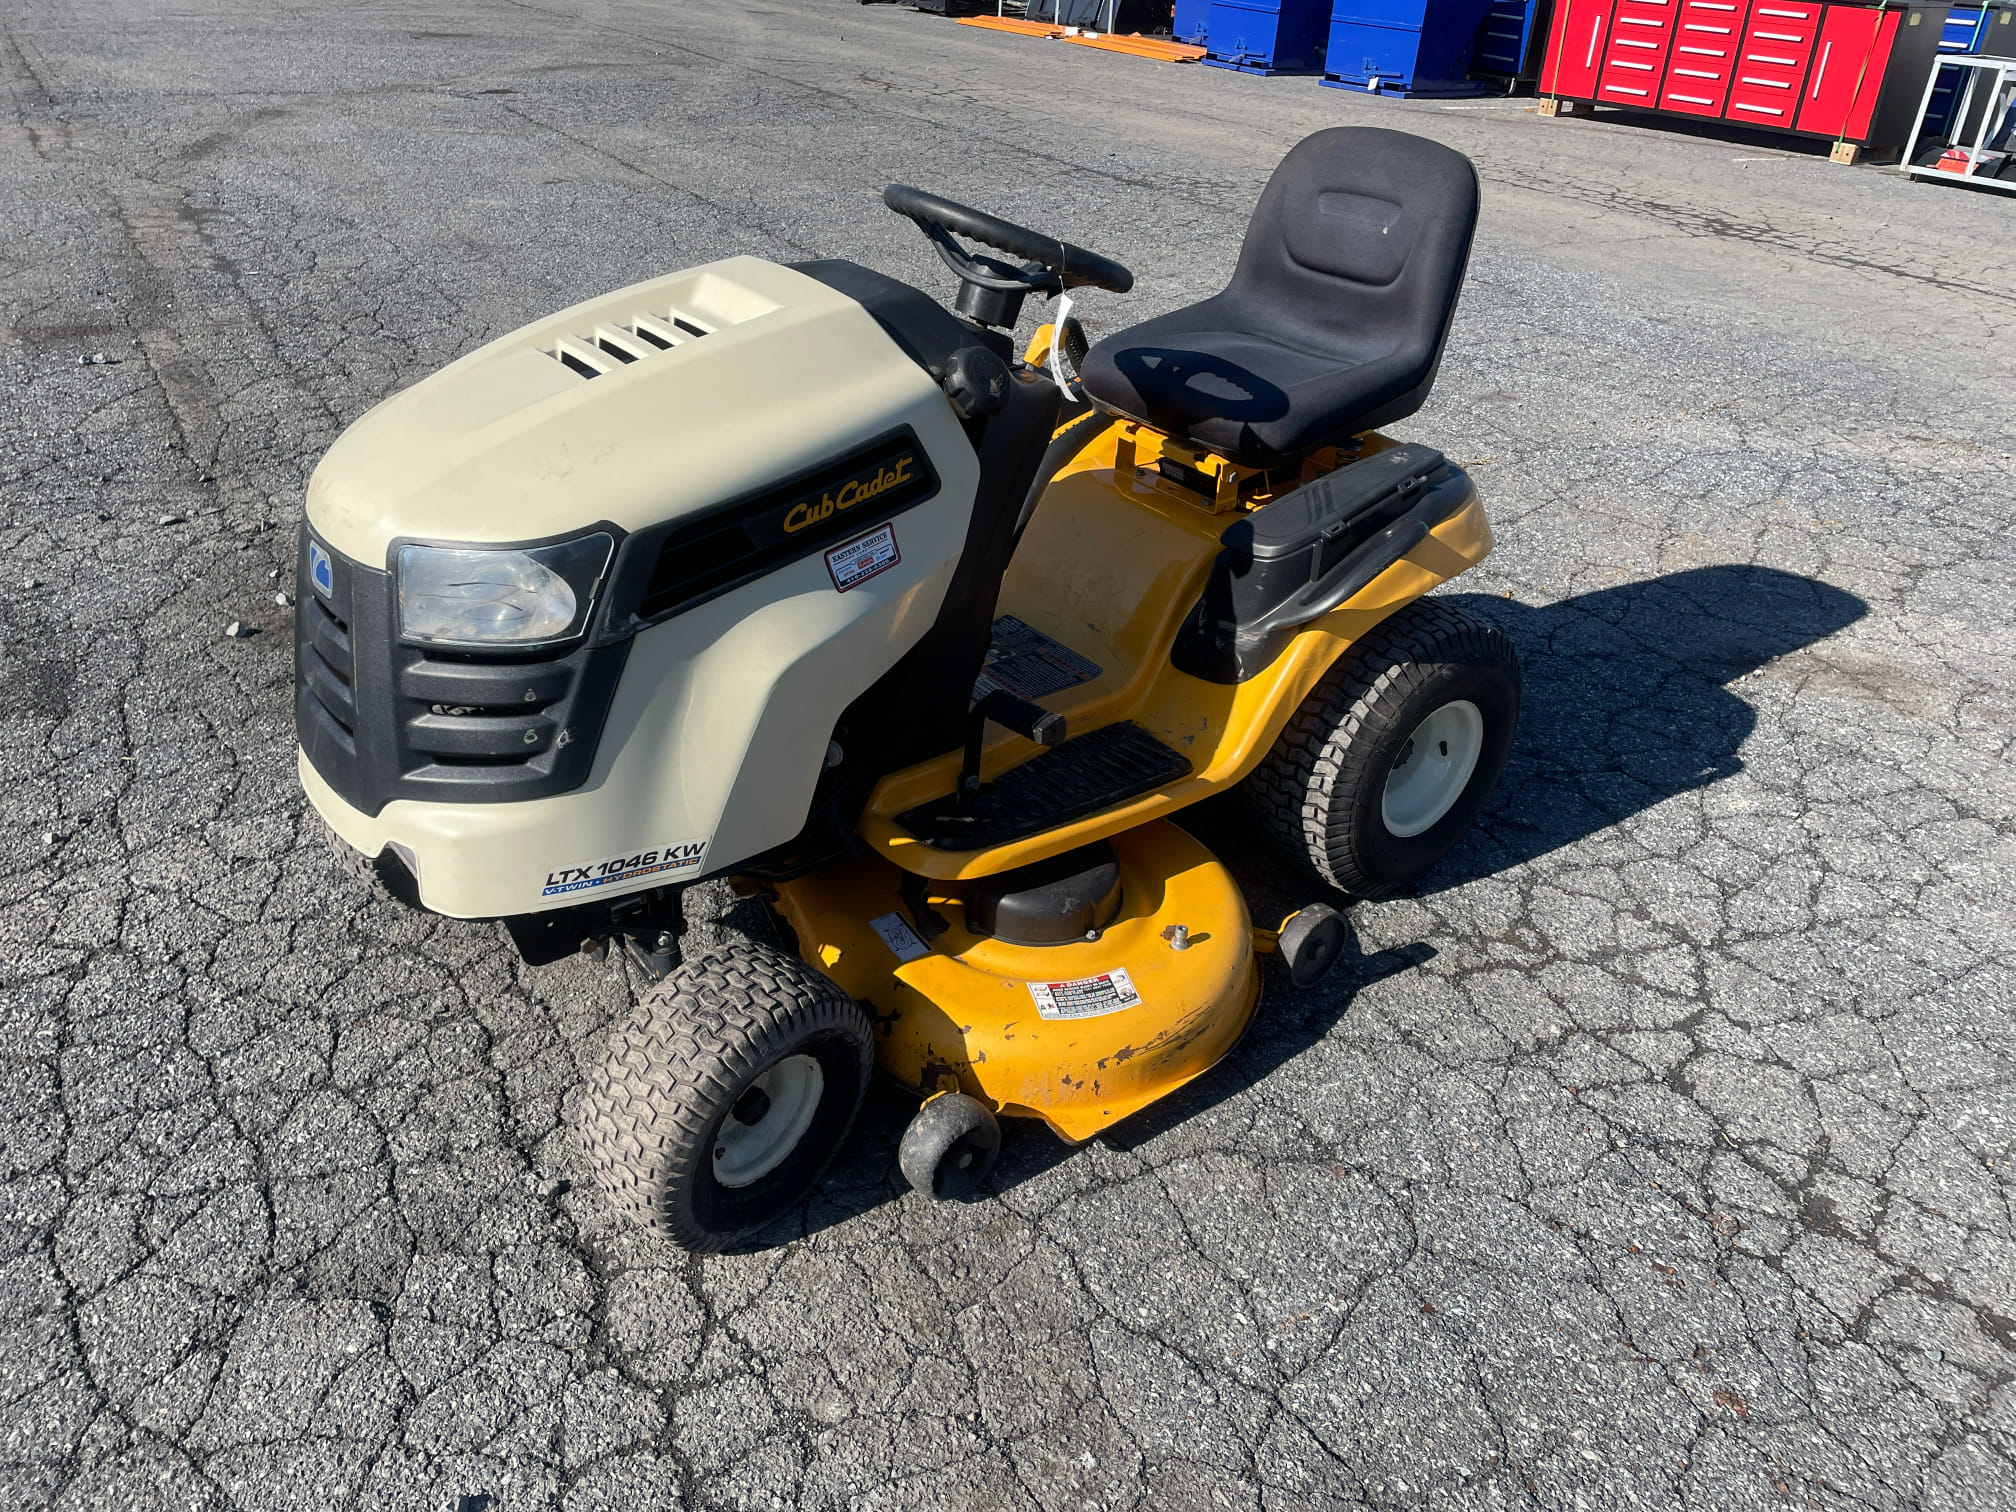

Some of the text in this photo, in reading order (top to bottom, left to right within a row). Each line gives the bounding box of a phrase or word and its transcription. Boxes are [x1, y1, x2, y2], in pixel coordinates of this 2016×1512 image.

[783, 457, 913, 533] Cub Cadet
[832, 545, 860, 562] EASTERN
[862, 532, 888, 549] SERVICE
[544, 858, 699, 896] V-TWIN HYDROSTATIC
[545, 842, 707, 887] LTX 1046 KW
[1066, 978, 1099, 987] DANGER
